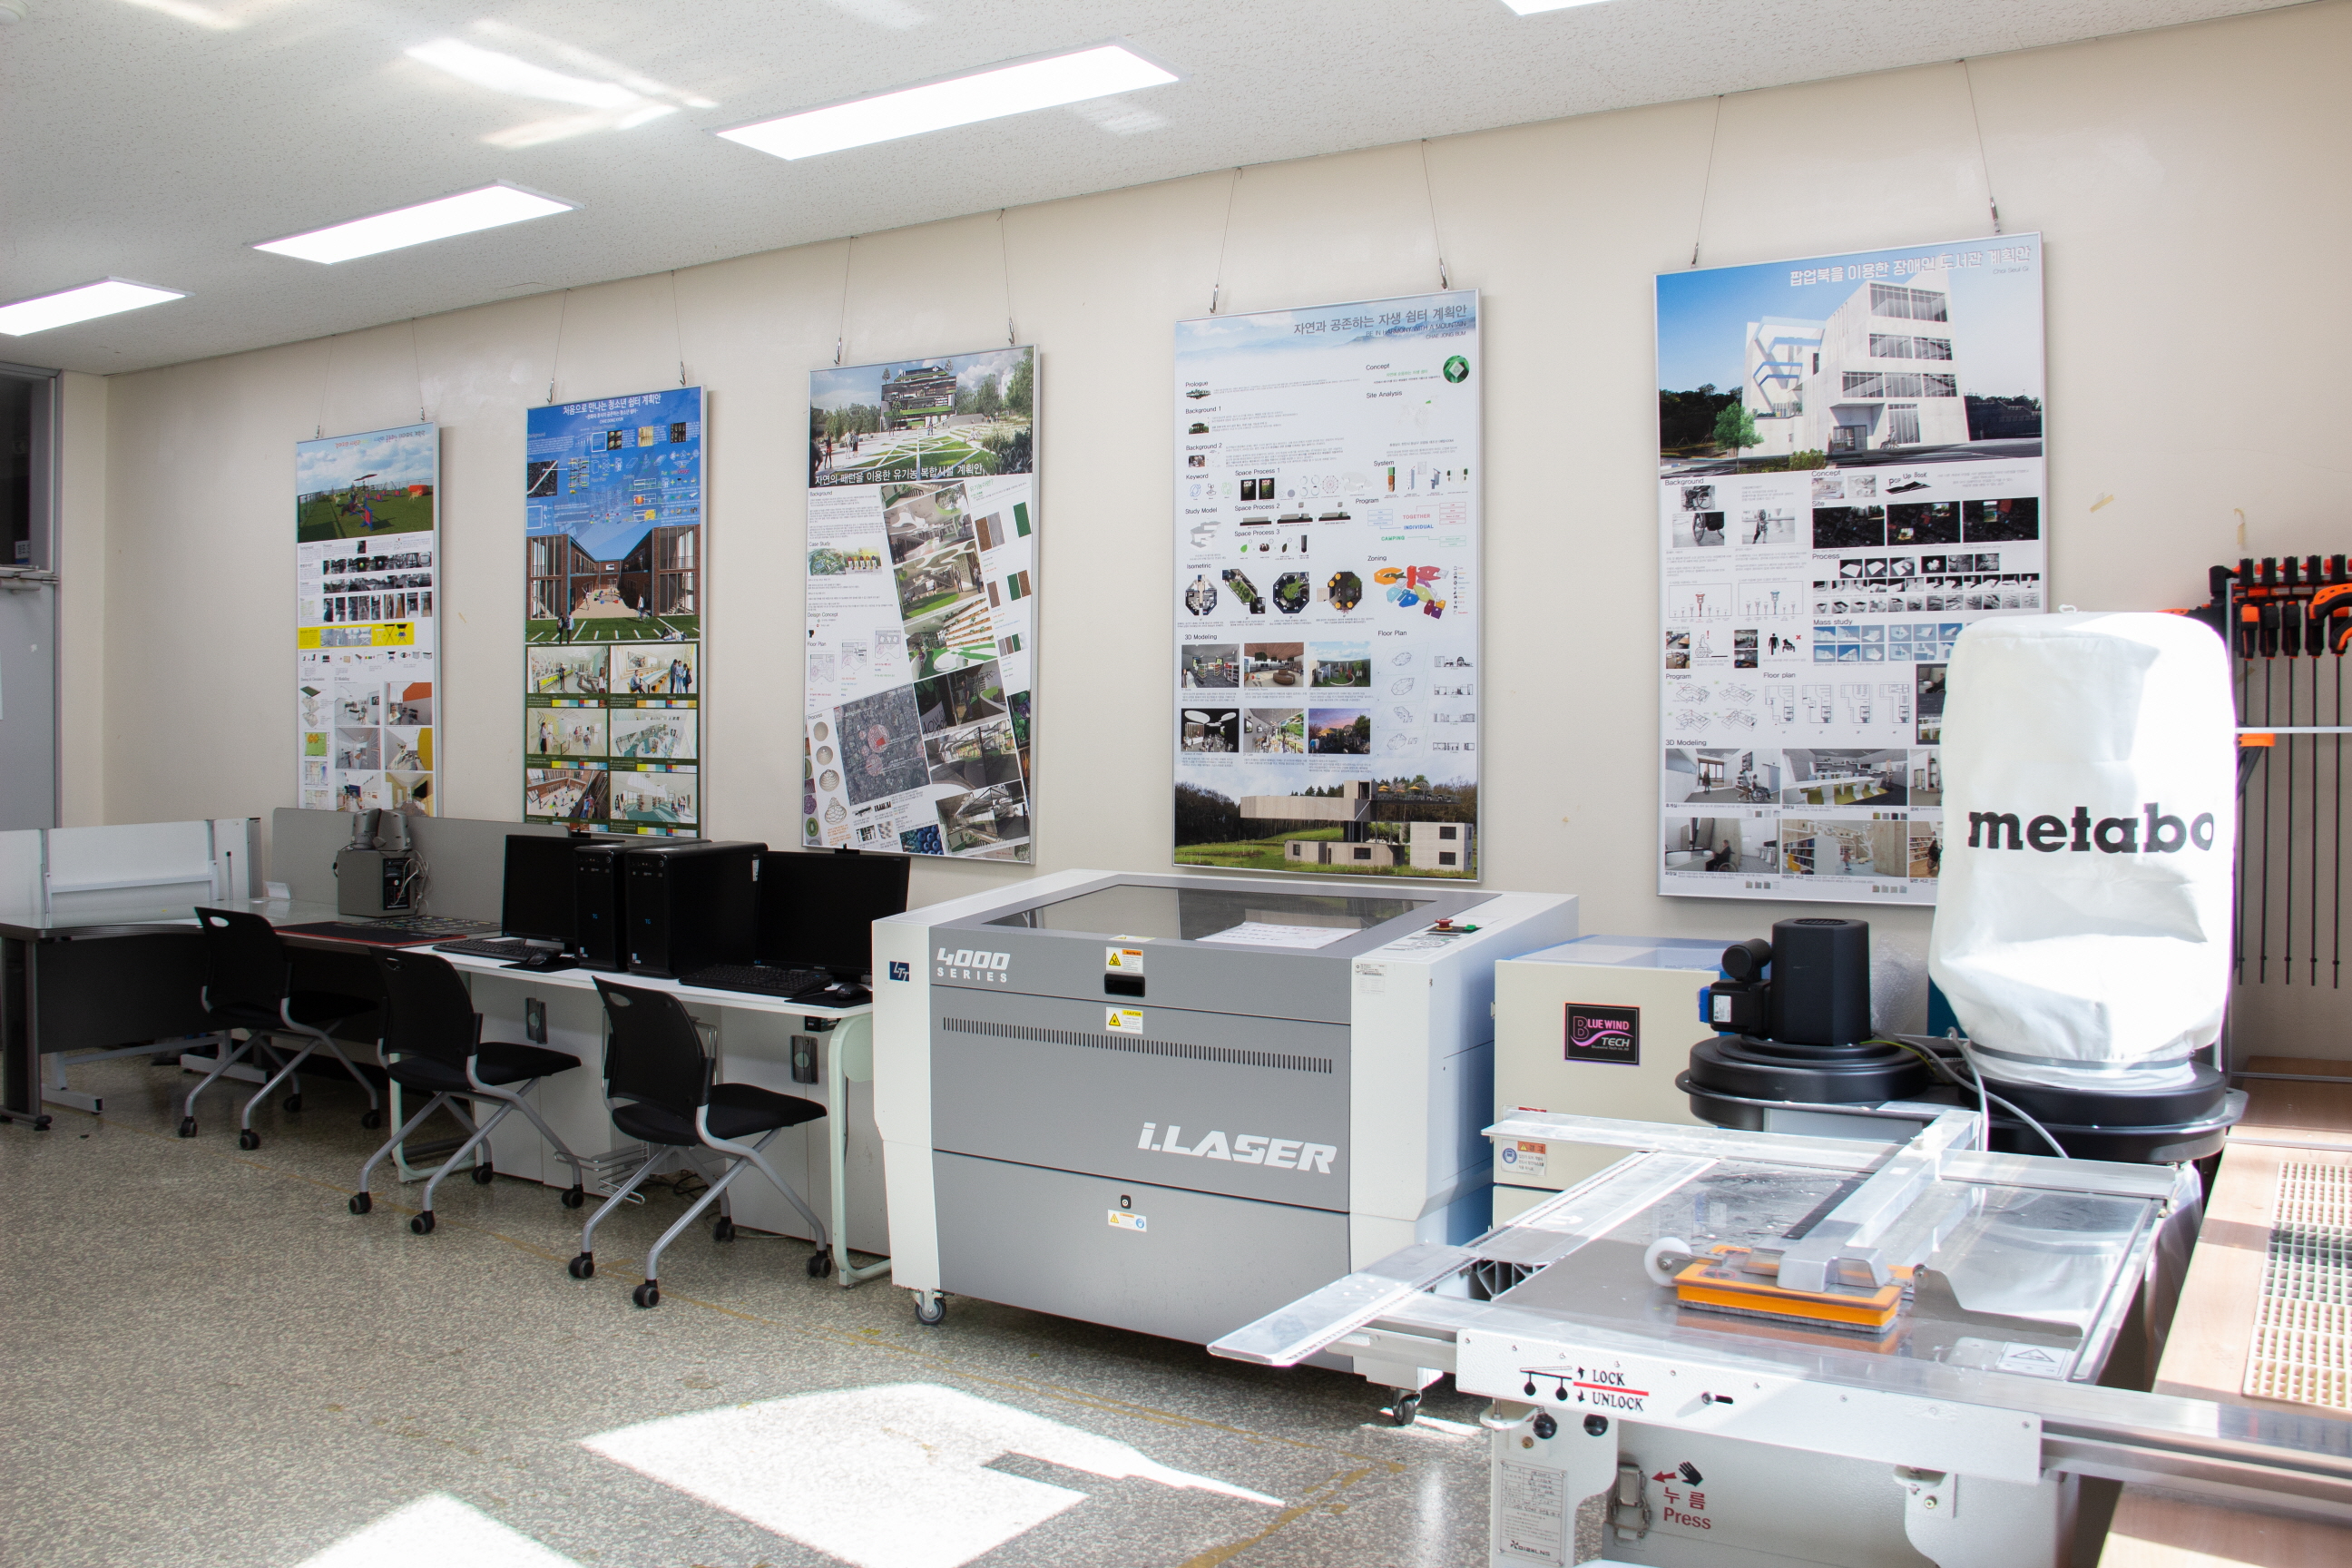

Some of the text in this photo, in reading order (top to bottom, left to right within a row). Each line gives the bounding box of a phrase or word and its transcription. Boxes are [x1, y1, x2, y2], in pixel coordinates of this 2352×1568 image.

[1789, 245, 2032, 286] 팝업북을 이용한 장애인 도서관 계획안
[1293, 304, 1467, 335] 자연과 공존하는 자생 쉼터 계획안
[1383, 327, 1413, 336] HARMONY
[1436, 320, 1466, 330] MOUNTAIN
[1185, 380, 1209, 388] Prologue
[563, 393, 662, 416] 처음으로 만나는 청소년 쉼터 계획안
[1185, 407, 1217, 415] Background
[814, 463, 983, 486] 자연의 패턴을 이용한 유기농 복합시설 계획안
[1811, 469, 1841, 477] Concept
[1664, 477, 1704, 486] Background
[1833, 618, 1853, 626] study
[1193, 633, 1218, 642] Modeling
[1665, 672, 1691, 681] Program
[1781, 671, 1796, 680] plan
[1676, 738, 1707, 747] Modeling
[1967, 802, 2214, 854] metabo
[936, 947, 1011, 970] 4000
[936, 966, 1007, 983] SERIES
[1601, 1036, 1631, 1047] TECH
[1137, 1122, 1338, 1174] i.LASER
[1592, 1369, 1625, 1386] LOCK
[1592, 1391, 1644, 1411] UNLOCK
[1663, 1506, 1711, 1530] Press
